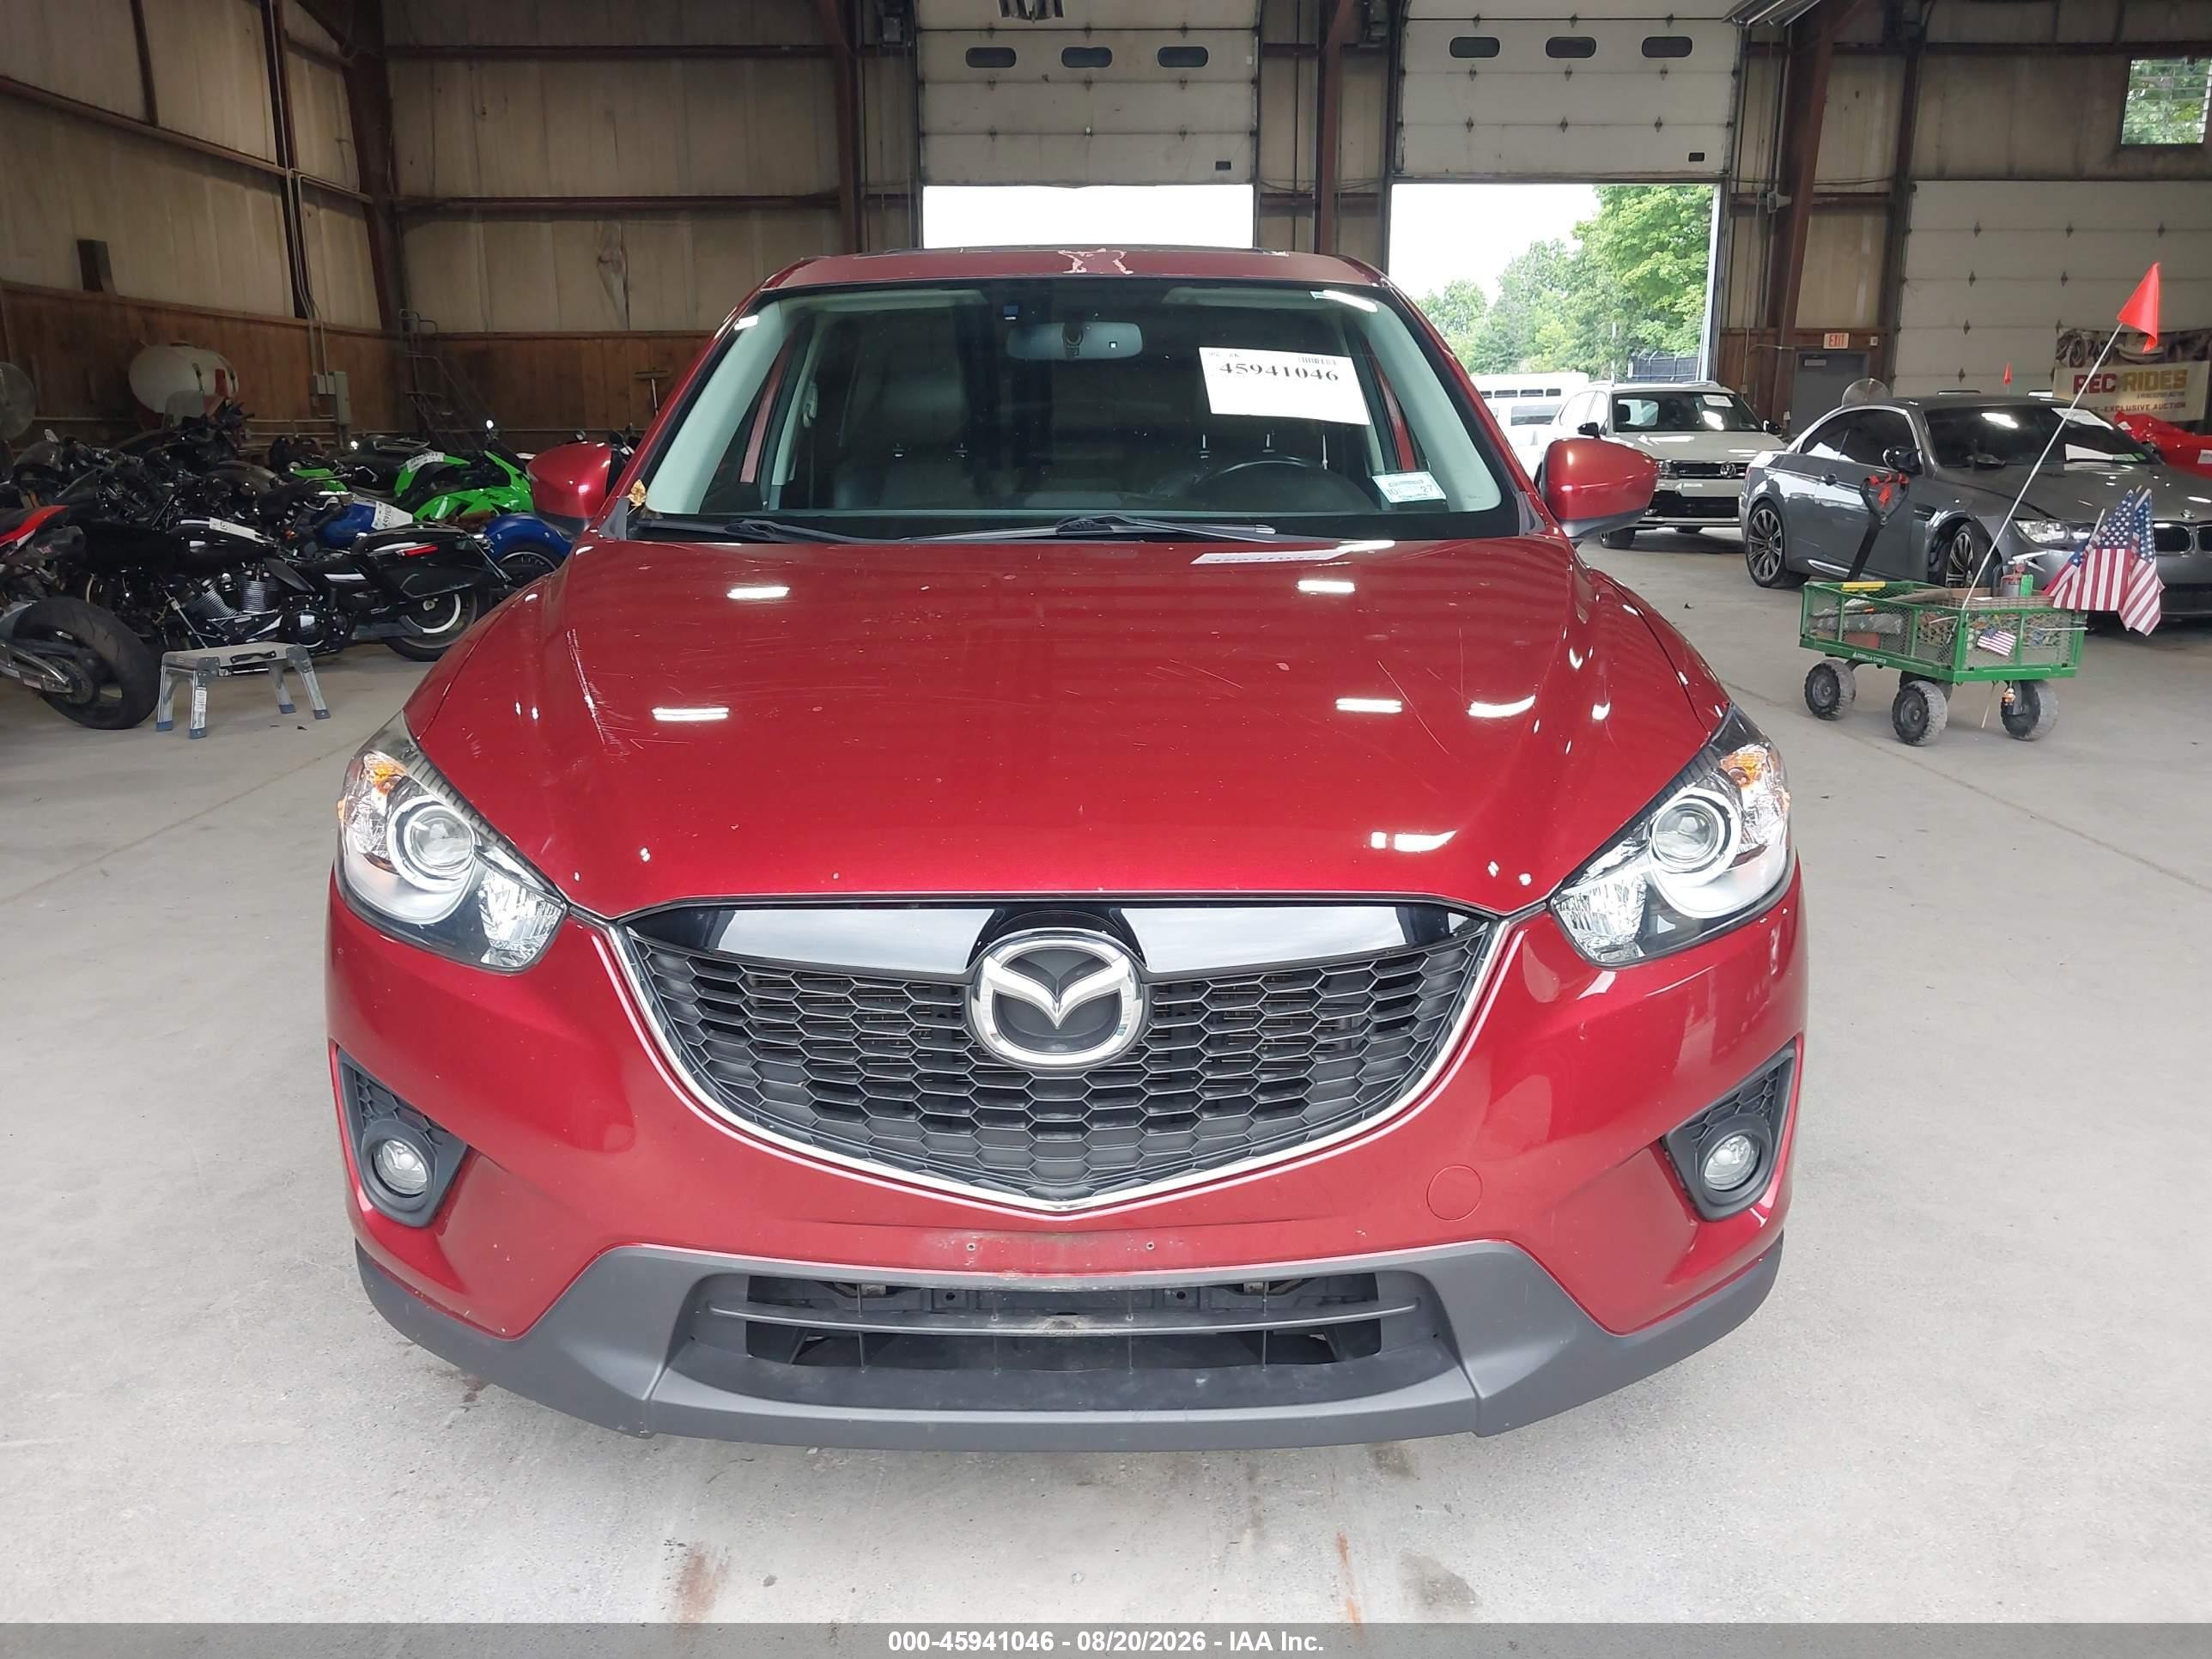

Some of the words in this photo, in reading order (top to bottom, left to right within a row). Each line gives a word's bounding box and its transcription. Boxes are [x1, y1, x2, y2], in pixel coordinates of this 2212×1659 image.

[1827, 335, 1845, 347] EXIT
[1219, 362, 1340, 381] 45941046
[2074, 373, 2117, 394] REC
[2122, 369, 2187, 392] RIDES
